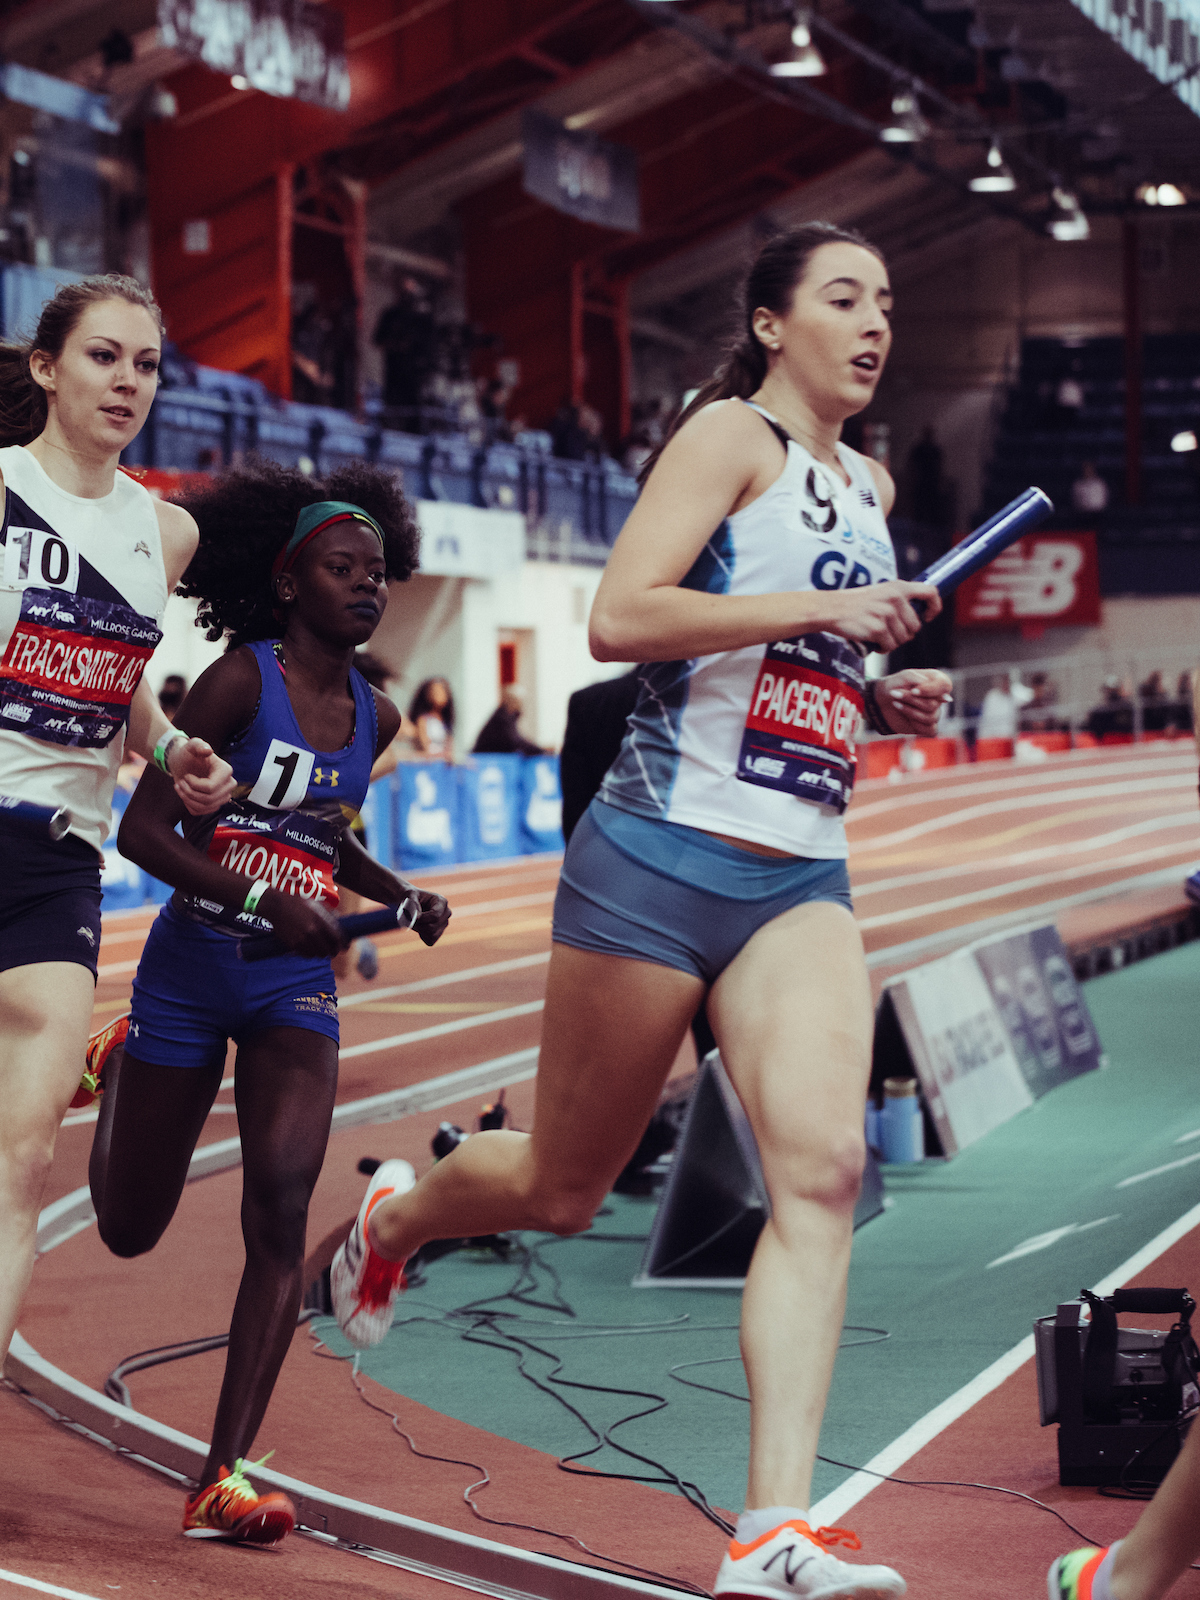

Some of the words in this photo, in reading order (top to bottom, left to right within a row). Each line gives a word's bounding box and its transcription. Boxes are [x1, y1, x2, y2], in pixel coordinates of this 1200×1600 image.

[800, 466, 837, 533] 9
[12, 531, 70, 585] 10
[90, 619, 131, 636] MILLROSE
[130, 627, 160, 642] GAMES
[8, 632, 126, 691] TRACKSMITH
[113, 656, 146, 694] AC
[267, 751, 300, 808] 1
[285, 828, 321, 849] MILLROSE
[221, 839, 327, 902] MONROE
